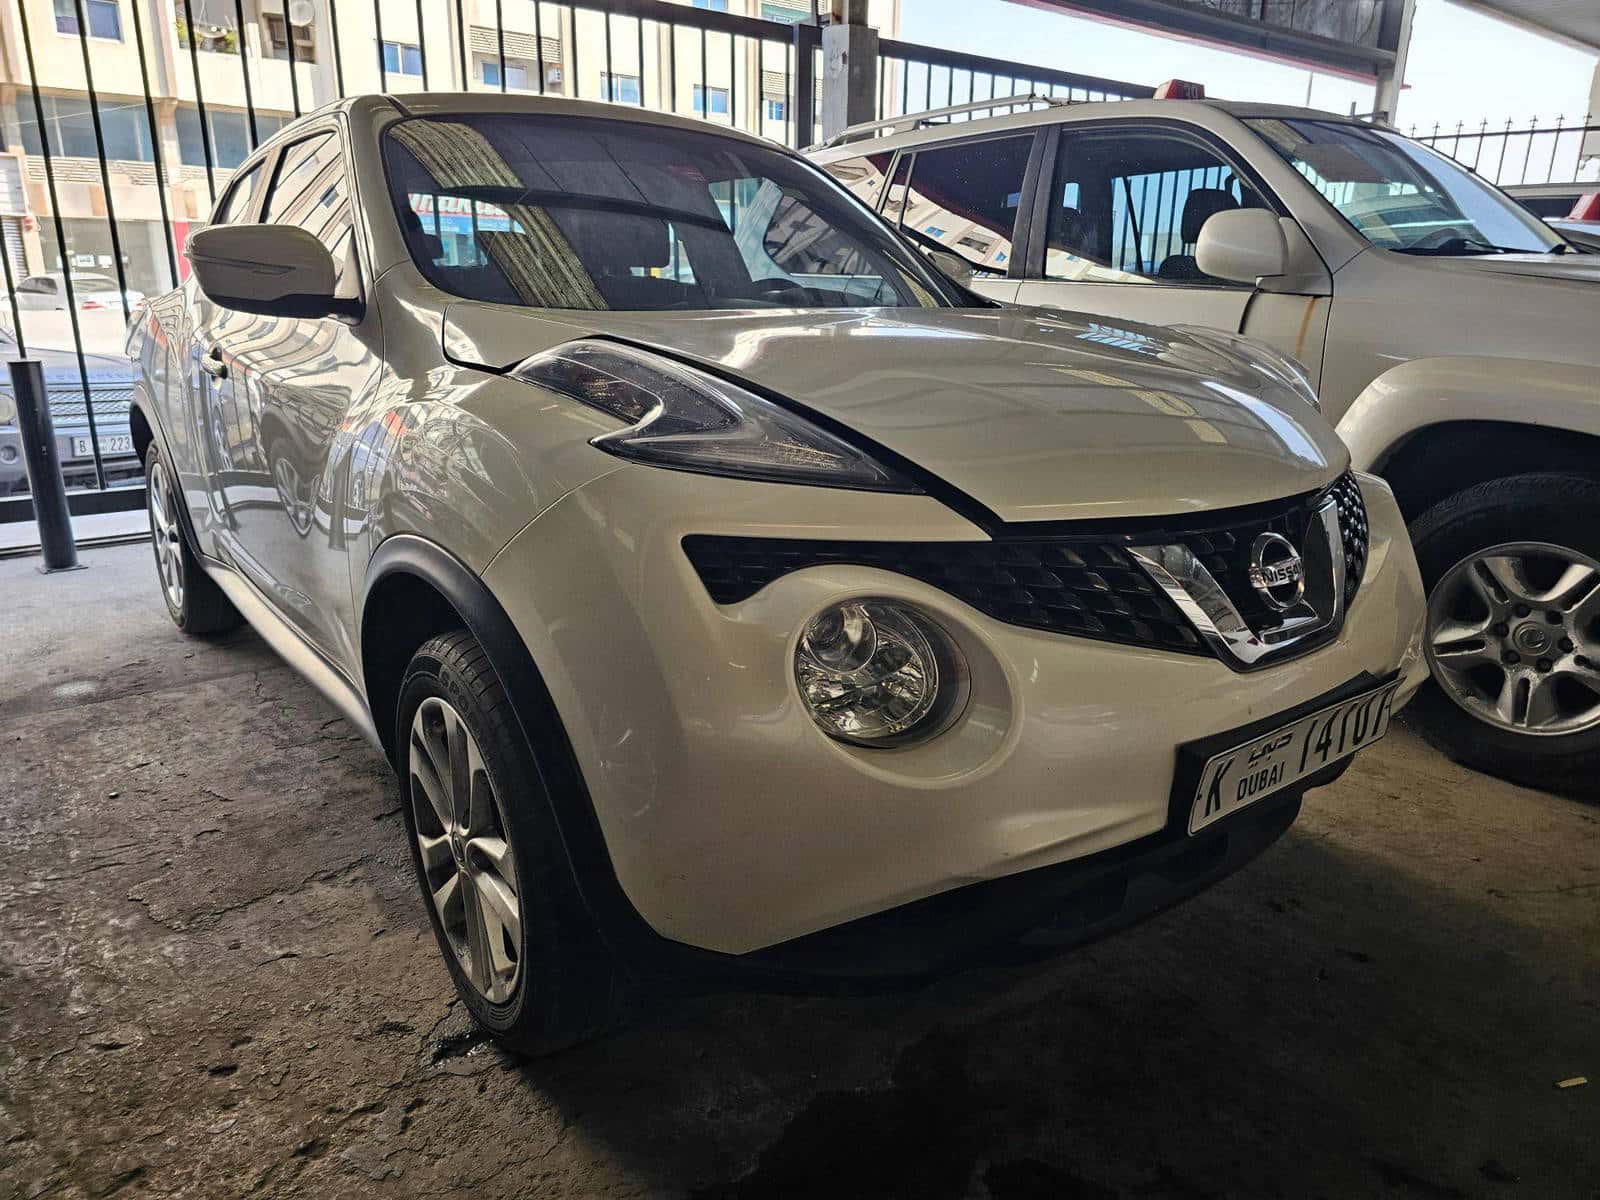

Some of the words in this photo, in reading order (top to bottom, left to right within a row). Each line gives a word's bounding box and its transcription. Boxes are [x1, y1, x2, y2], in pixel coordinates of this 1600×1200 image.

[1247, 733, 1292, 769] دبي
[1204, 755, 1235, 818] K
[1236, 760, 1285, 801] DUBAI
